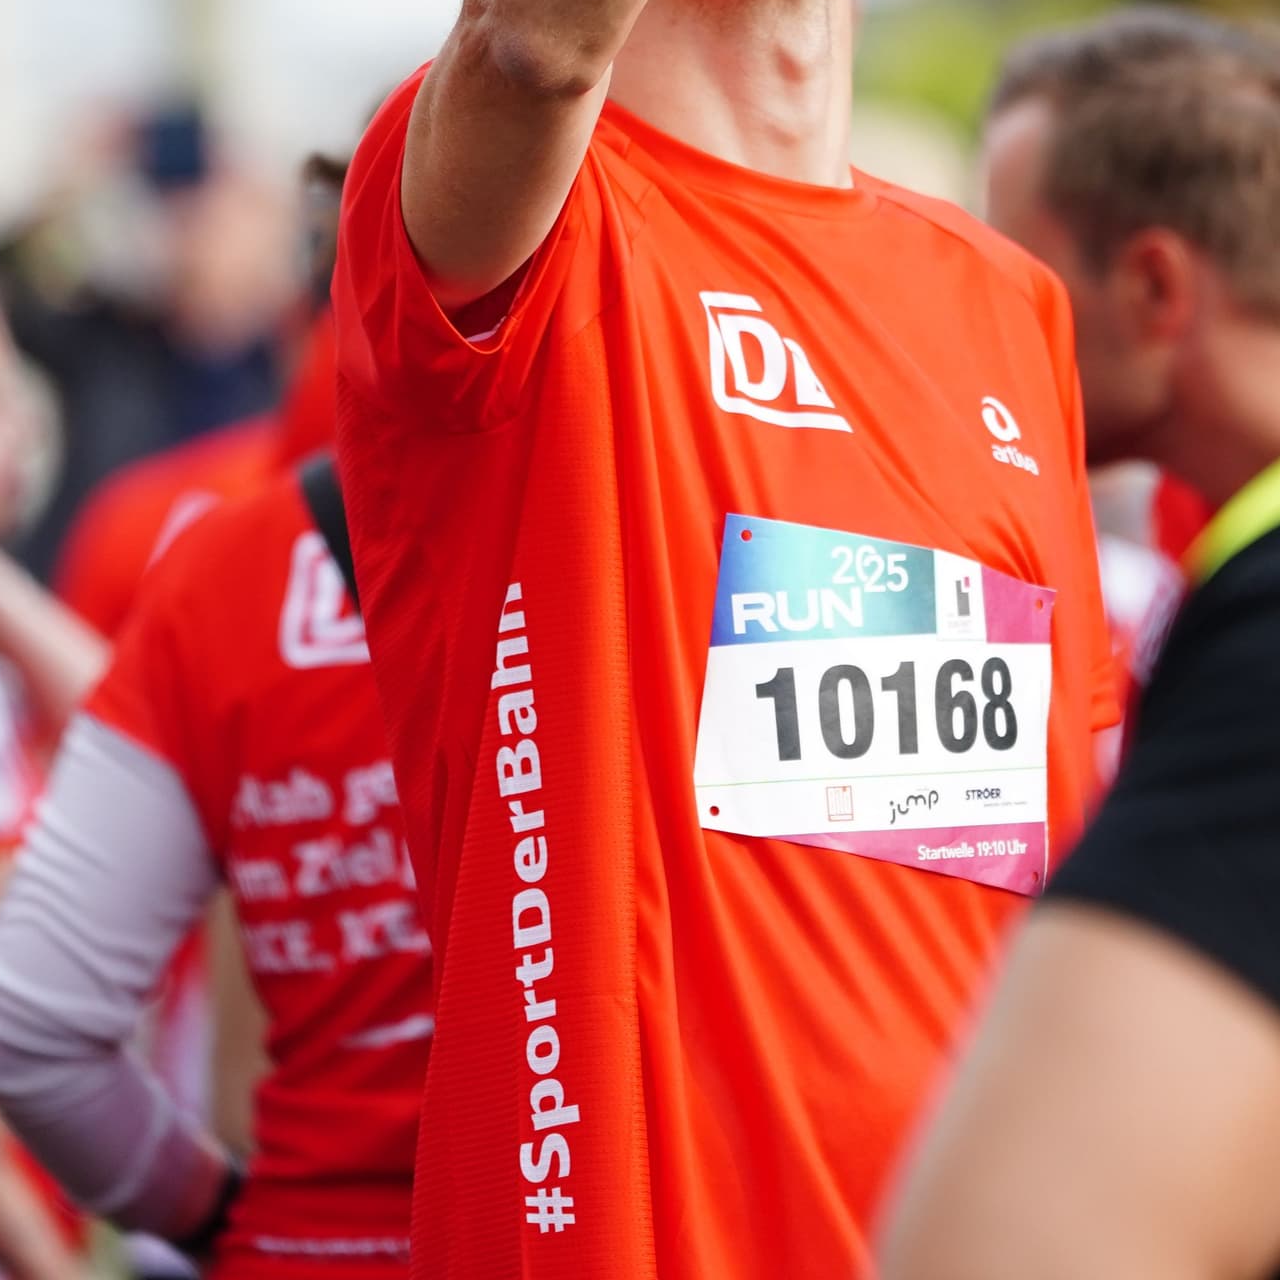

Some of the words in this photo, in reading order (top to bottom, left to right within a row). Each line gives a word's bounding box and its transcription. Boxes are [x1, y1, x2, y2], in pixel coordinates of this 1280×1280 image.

[731, 586, 864, 635] RUN
[755, 656, 1019, 762] 10168
[888, 790, 939, 825] jump
[917, 842, 975, 862] Startwelle
[1006, 838, 1028, 856] Uhr
